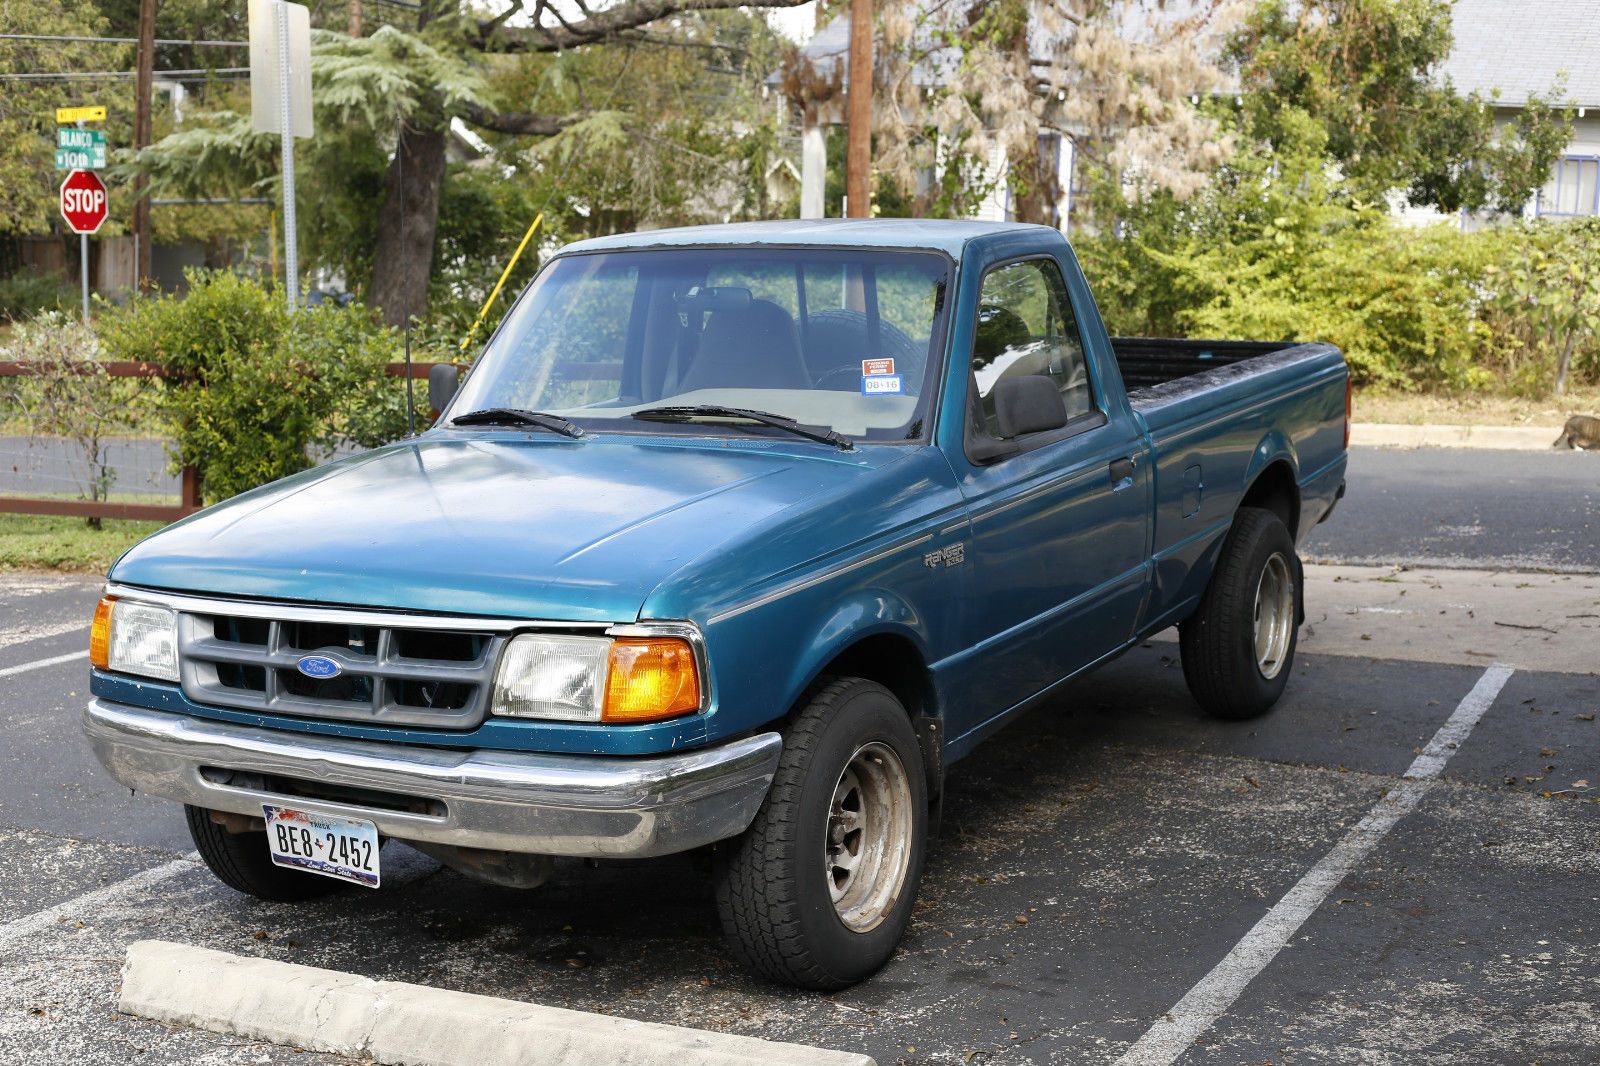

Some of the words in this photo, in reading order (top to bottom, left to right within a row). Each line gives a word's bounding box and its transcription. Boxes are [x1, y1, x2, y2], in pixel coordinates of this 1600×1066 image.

[60, 130, 93, 148] BLANCO
[65, 188, 105, 213] STOP
[306, 659, 331, 673] Ford
[307, 860, 321, 870] Lone
[322, 864, 336, 874] Star
[336, 867, 353, 878] State
